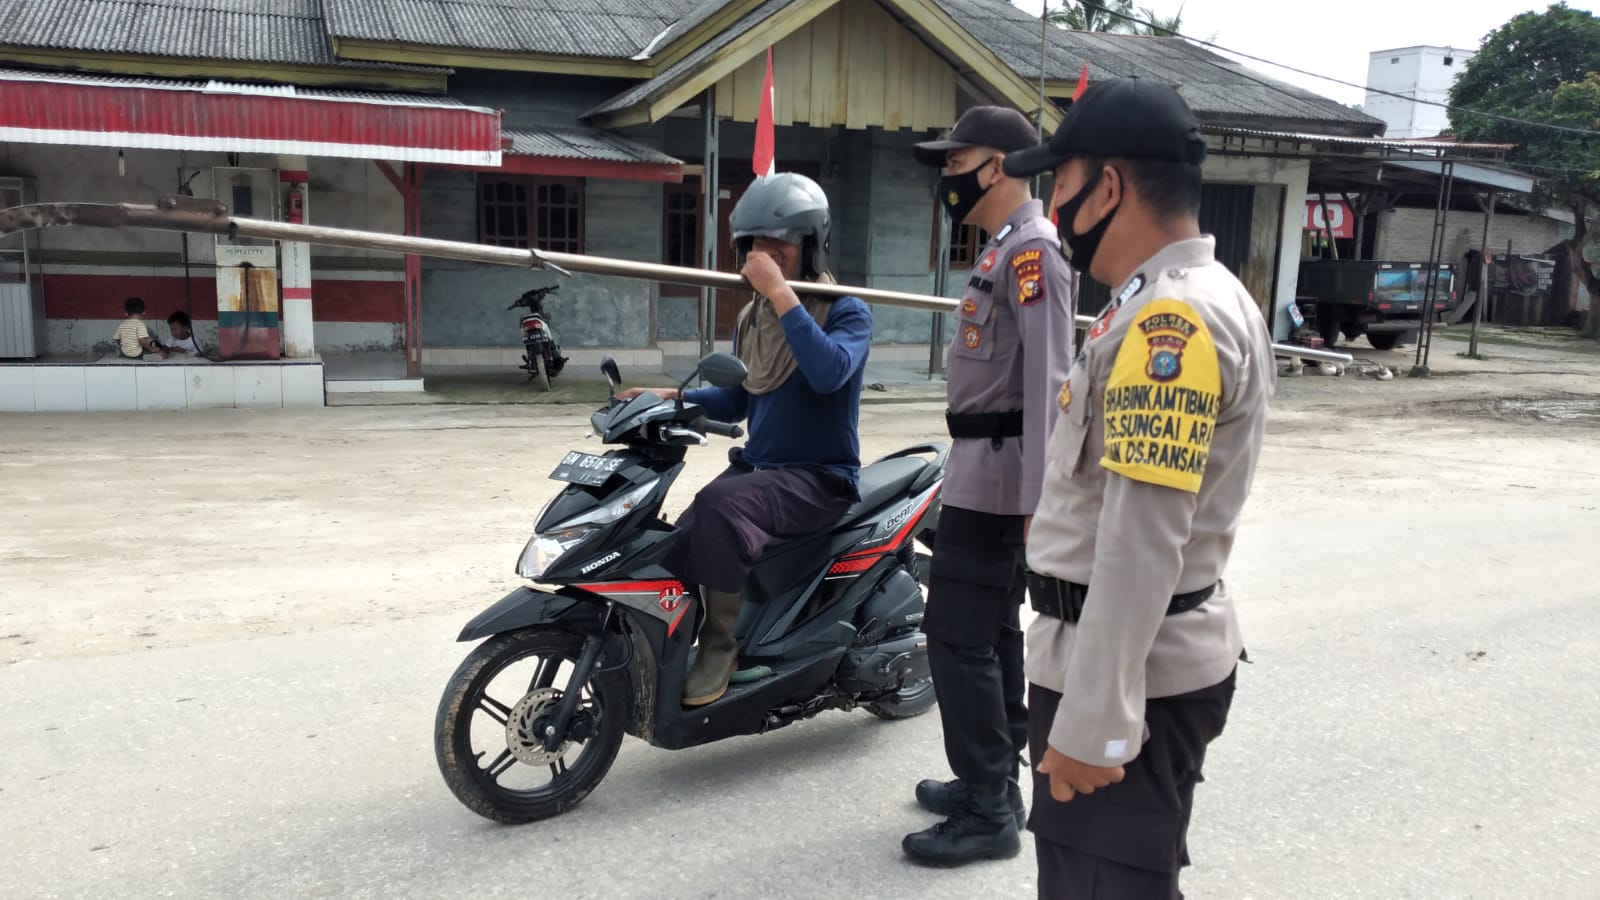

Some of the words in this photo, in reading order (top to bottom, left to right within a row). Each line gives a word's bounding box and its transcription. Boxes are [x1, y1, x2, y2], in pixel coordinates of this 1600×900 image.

[1152, 336, 1183, 345] RIAU
[579, 455, 608, 470] 6516
[580, 551, 621, 574] HONDA
